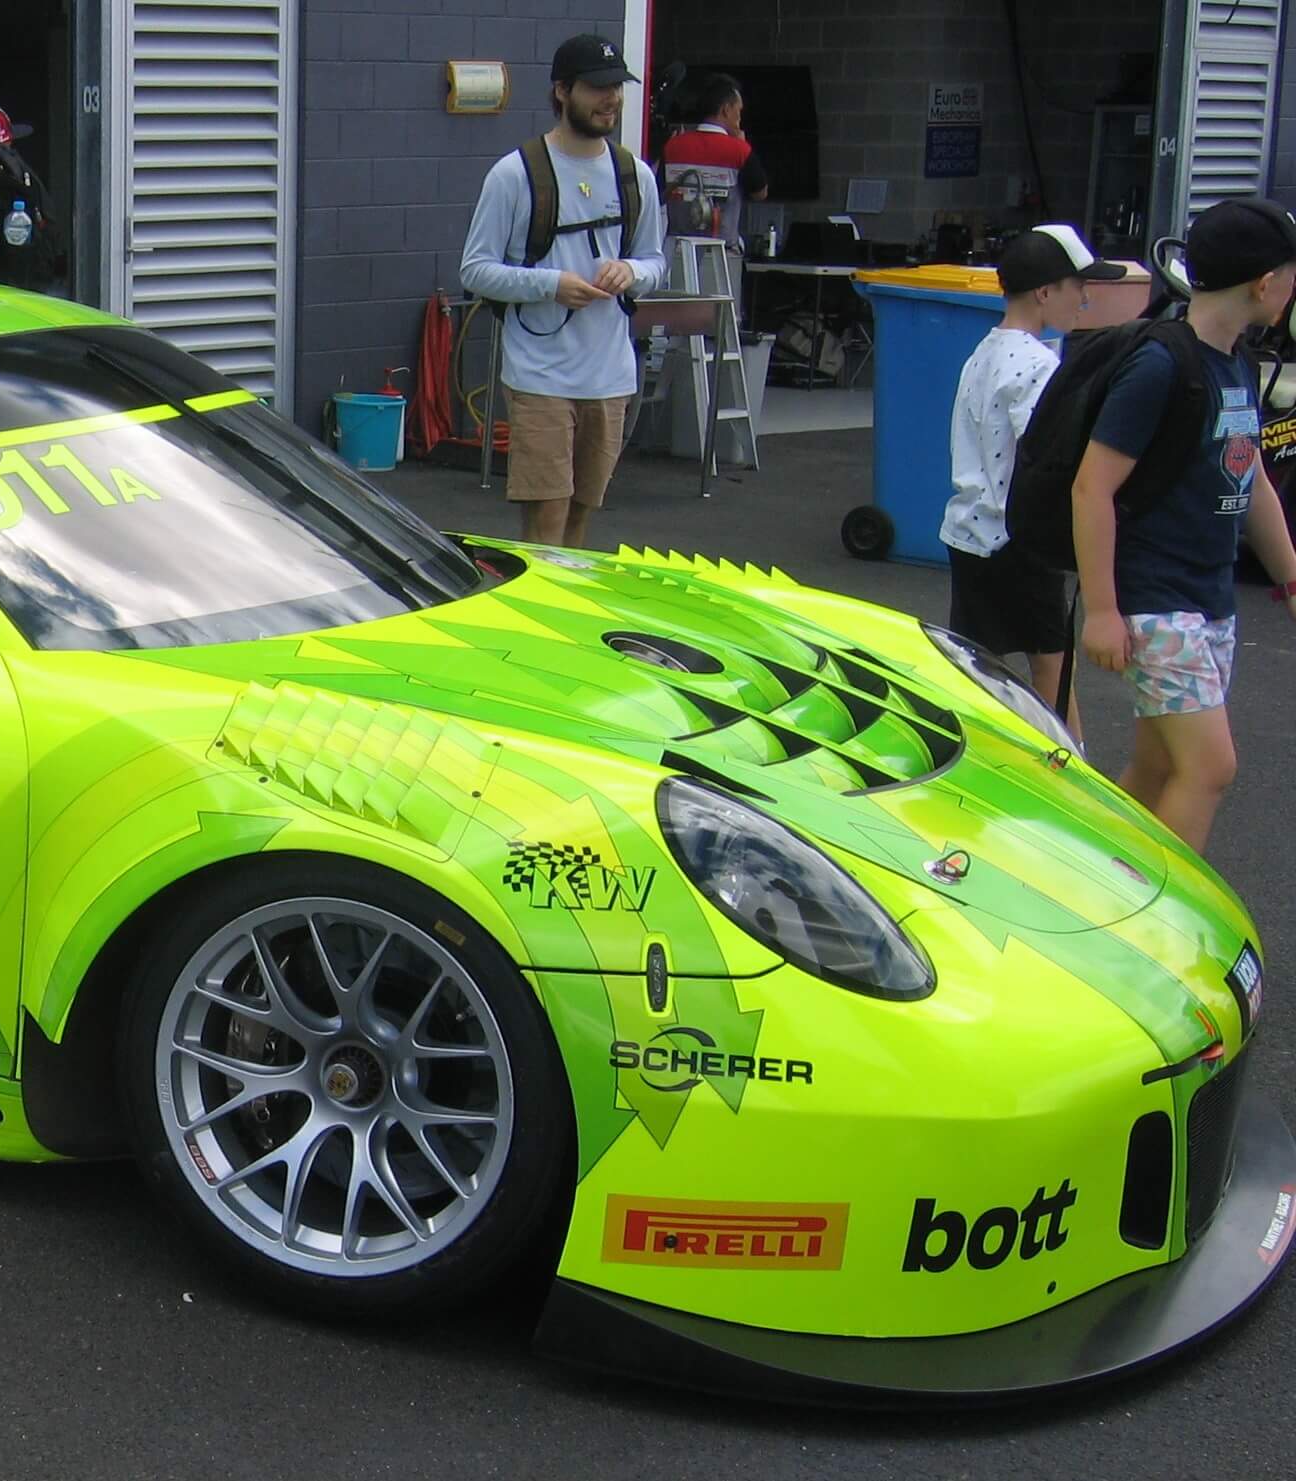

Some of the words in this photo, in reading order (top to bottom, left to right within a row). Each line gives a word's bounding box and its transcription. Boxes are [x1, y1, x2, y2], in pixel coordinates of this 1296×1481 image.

[83, 86, 100, 112] 03
[934, 88, 961, 105] Euro
[1159, 136, 1176, 157] 04
[530, 863, 656, 912] KW
[609, 1040, 814, 1085] SCHERER
[622, 1209, 828, 1258] PIRELLI
[901, 1178, 1078, 1274] bott
